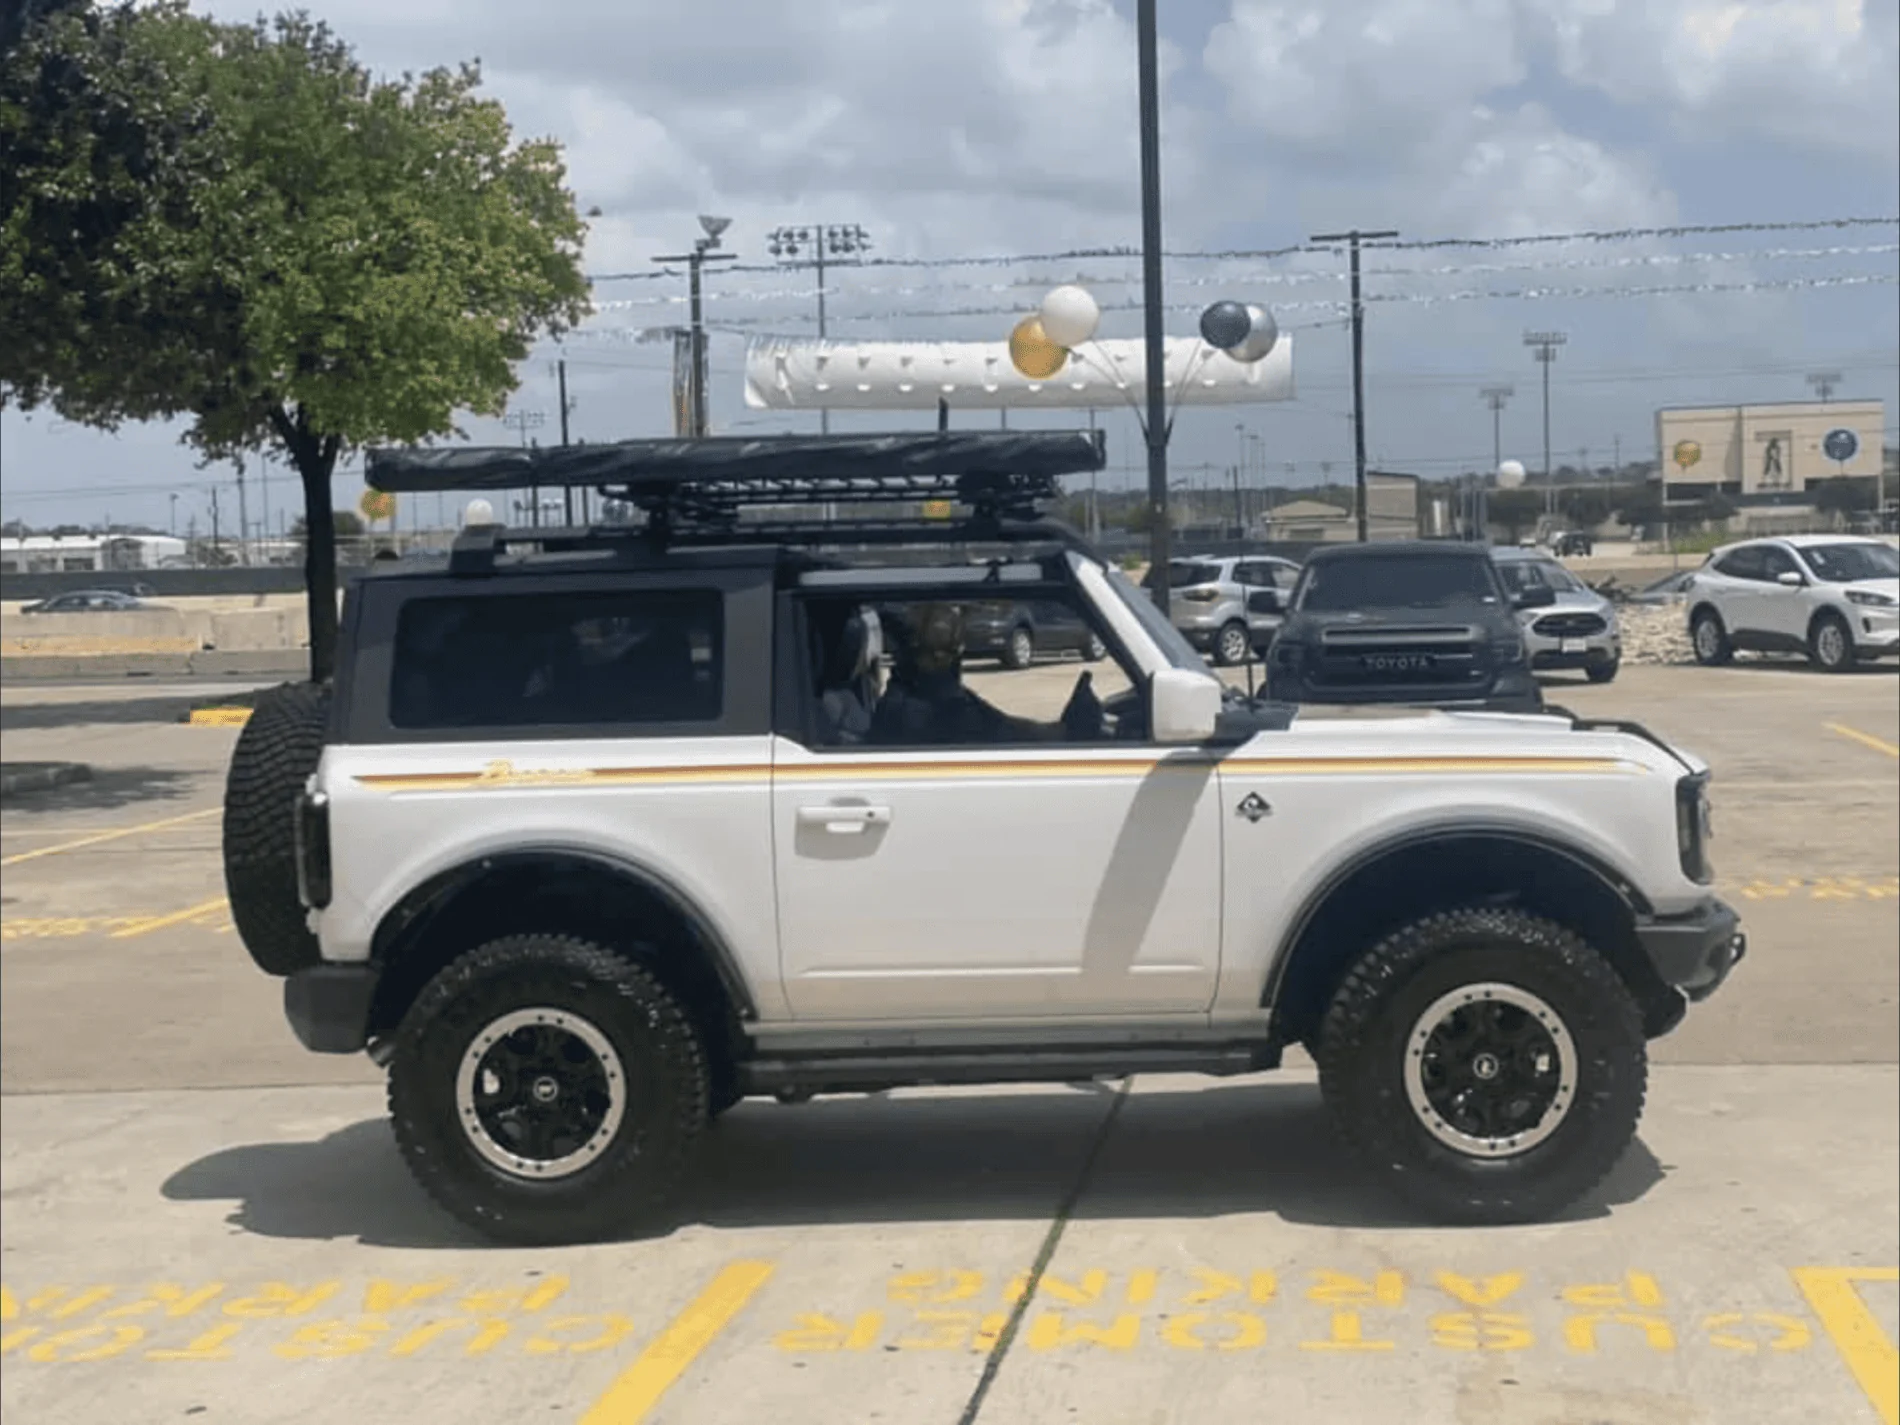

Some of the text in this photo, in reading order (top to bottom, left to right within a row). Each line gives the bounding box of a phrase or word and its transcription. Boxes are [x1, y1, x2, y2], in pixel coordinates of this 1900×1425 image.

[1365, 656, 1428, 669] TOYOTA
[887, 1267, 1663, 1306] PARKING
[772, 1310, 1814, 1353] CUSTOMER
